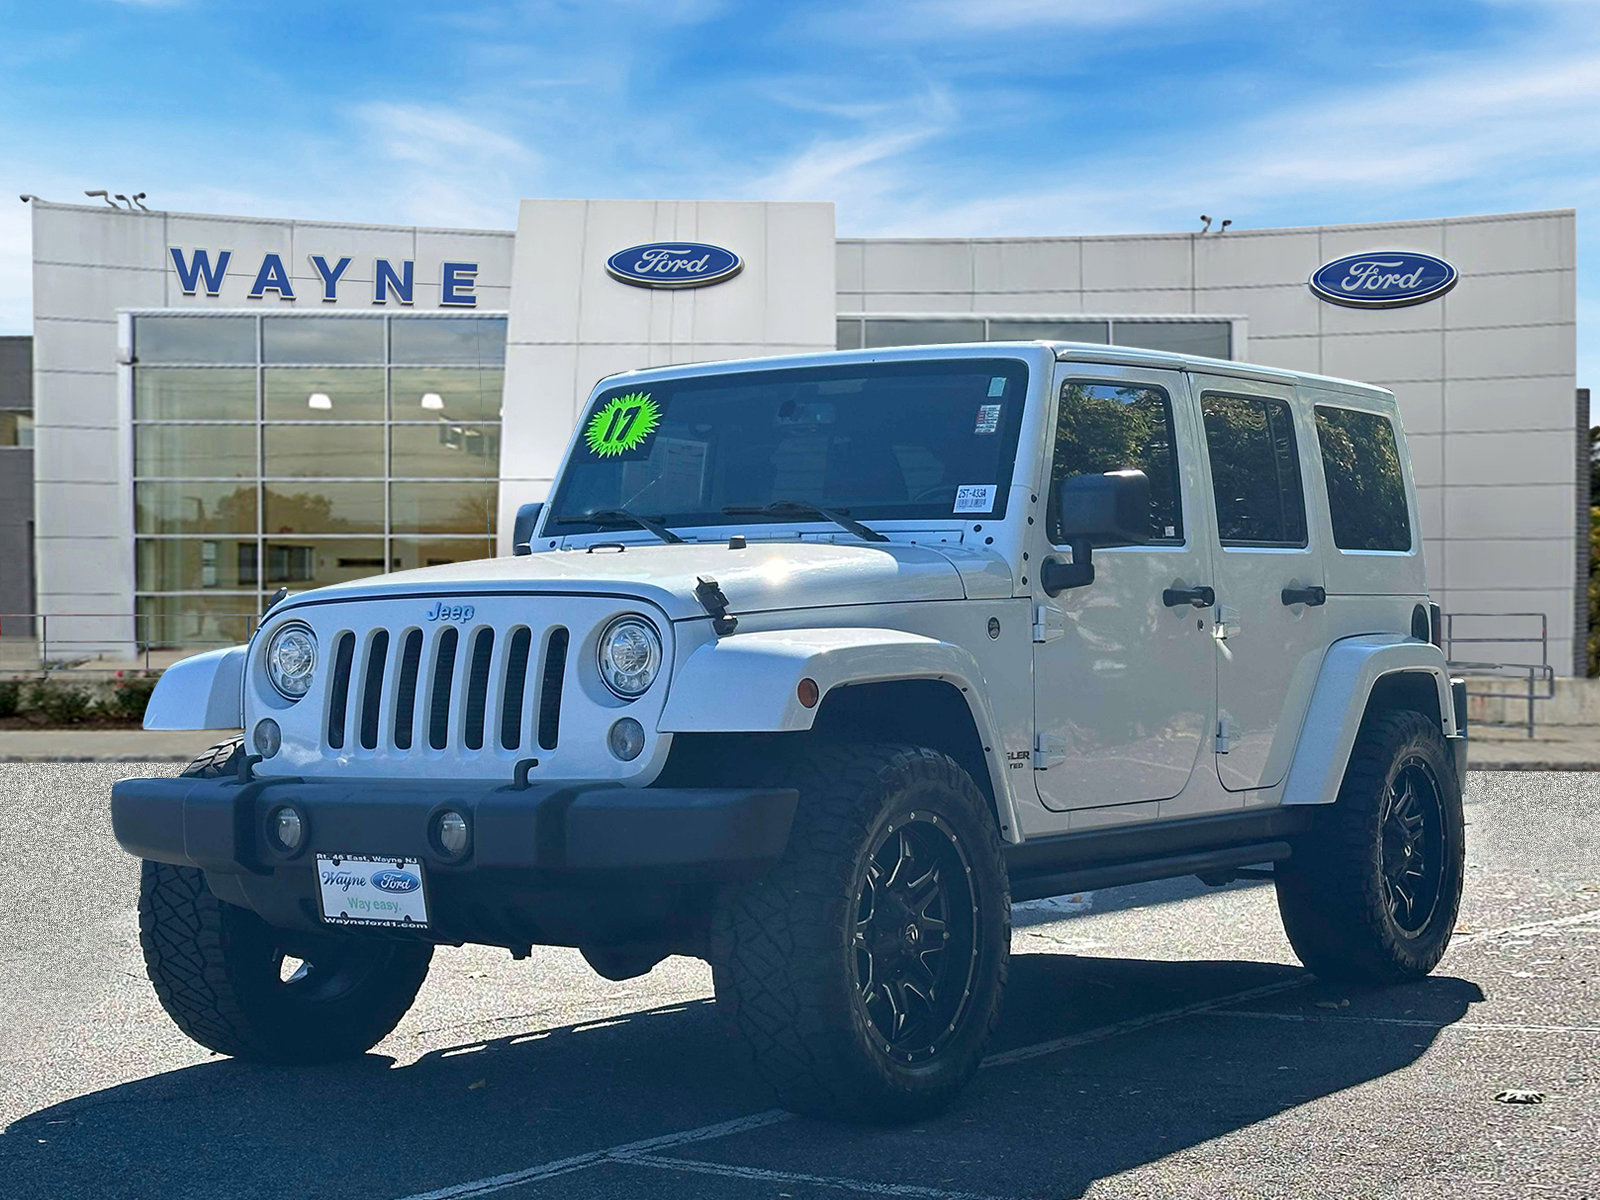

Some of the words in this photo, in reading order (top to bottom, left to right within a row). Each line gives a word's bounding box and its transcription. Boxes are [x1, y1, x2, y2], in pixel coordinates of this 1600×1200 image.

[634, 248, 711, 273] Ford
[169, 246, 479, 307] WAYNE
[1340, 261, 1425, 292] Ford
[602, 405, 642, 443] 17
[426, 601, 475, 624] Jeep
[347, 854, 370, 862] East,
[371, 855, 403, 864] Wayne
[321, 871, 367, 893] Wayne
[380, 873, 411, 890] Ford
[347, 897, 371, 912] Way
[373, 901, 402, 914] easy.
[324, 917, 428, 929] Wayneford1.com
